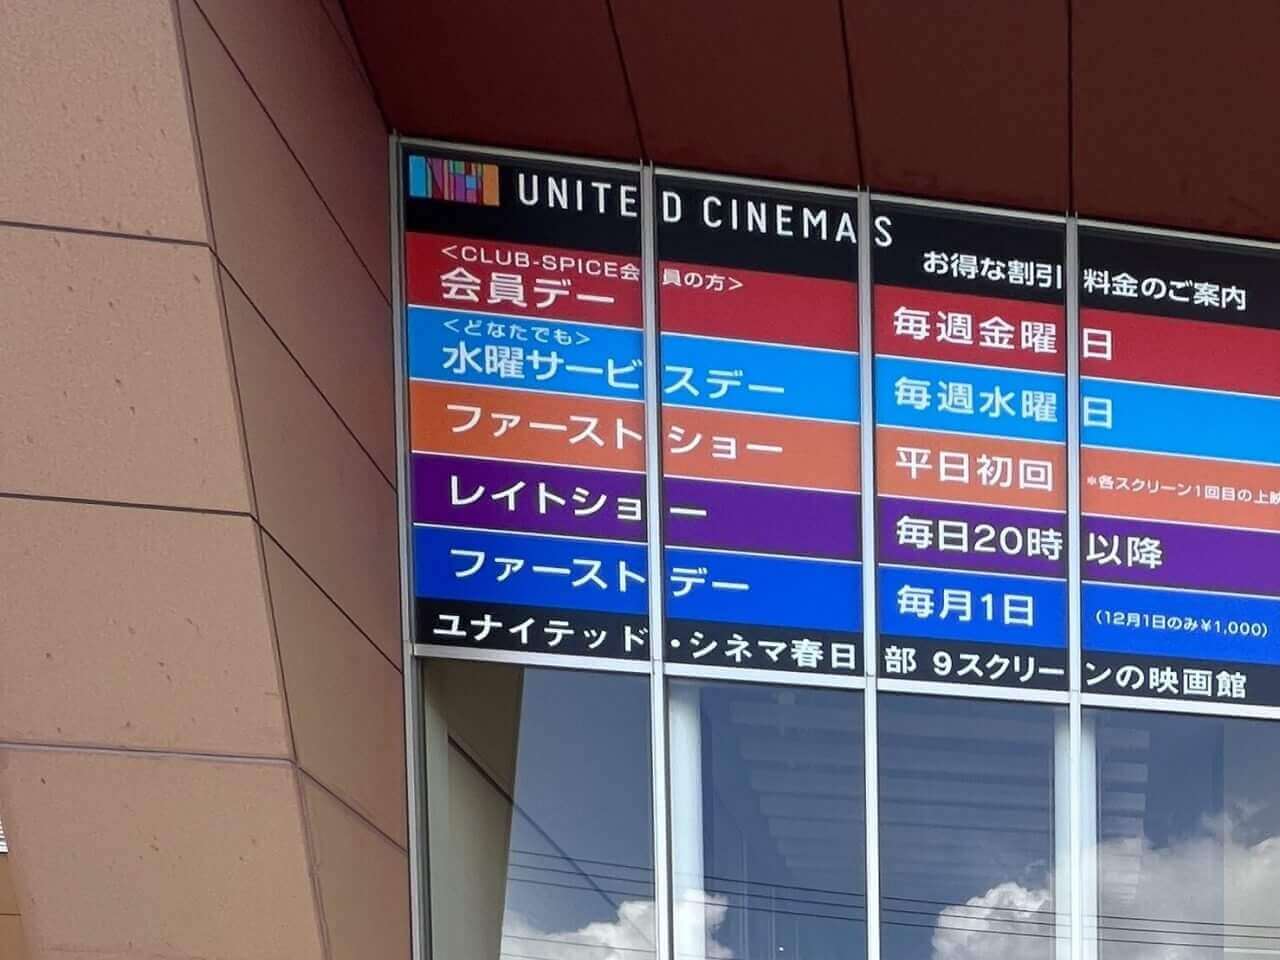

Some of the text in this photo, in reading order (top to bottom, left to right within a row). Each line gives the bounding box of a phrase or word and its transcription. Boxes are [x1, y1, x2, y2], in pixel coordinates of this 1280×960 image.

[517, 173, 895, 248] UNITED CINEMAS
[440, 267, 615, 304] 会員デー
[922, 250, 1247, 311] お得な割引料金のご案内
[893, 305, 1114, 362] 毎週金曜日
[442, 342, 785, 400] 水曜サービスデー
[894, 376, 1114, 430] 毎週水曜日
[446, 403, 784, 461] ファーストショー
[896, 446, 1054, 493] 平日初回
[450, 474, 708, 521] レイトショー
[896, 515, 1163, 570] 毎日20時以降
[449, 548, 750, 598] ファーストデー
[896, 584, 1035, 627] 毎月1日
